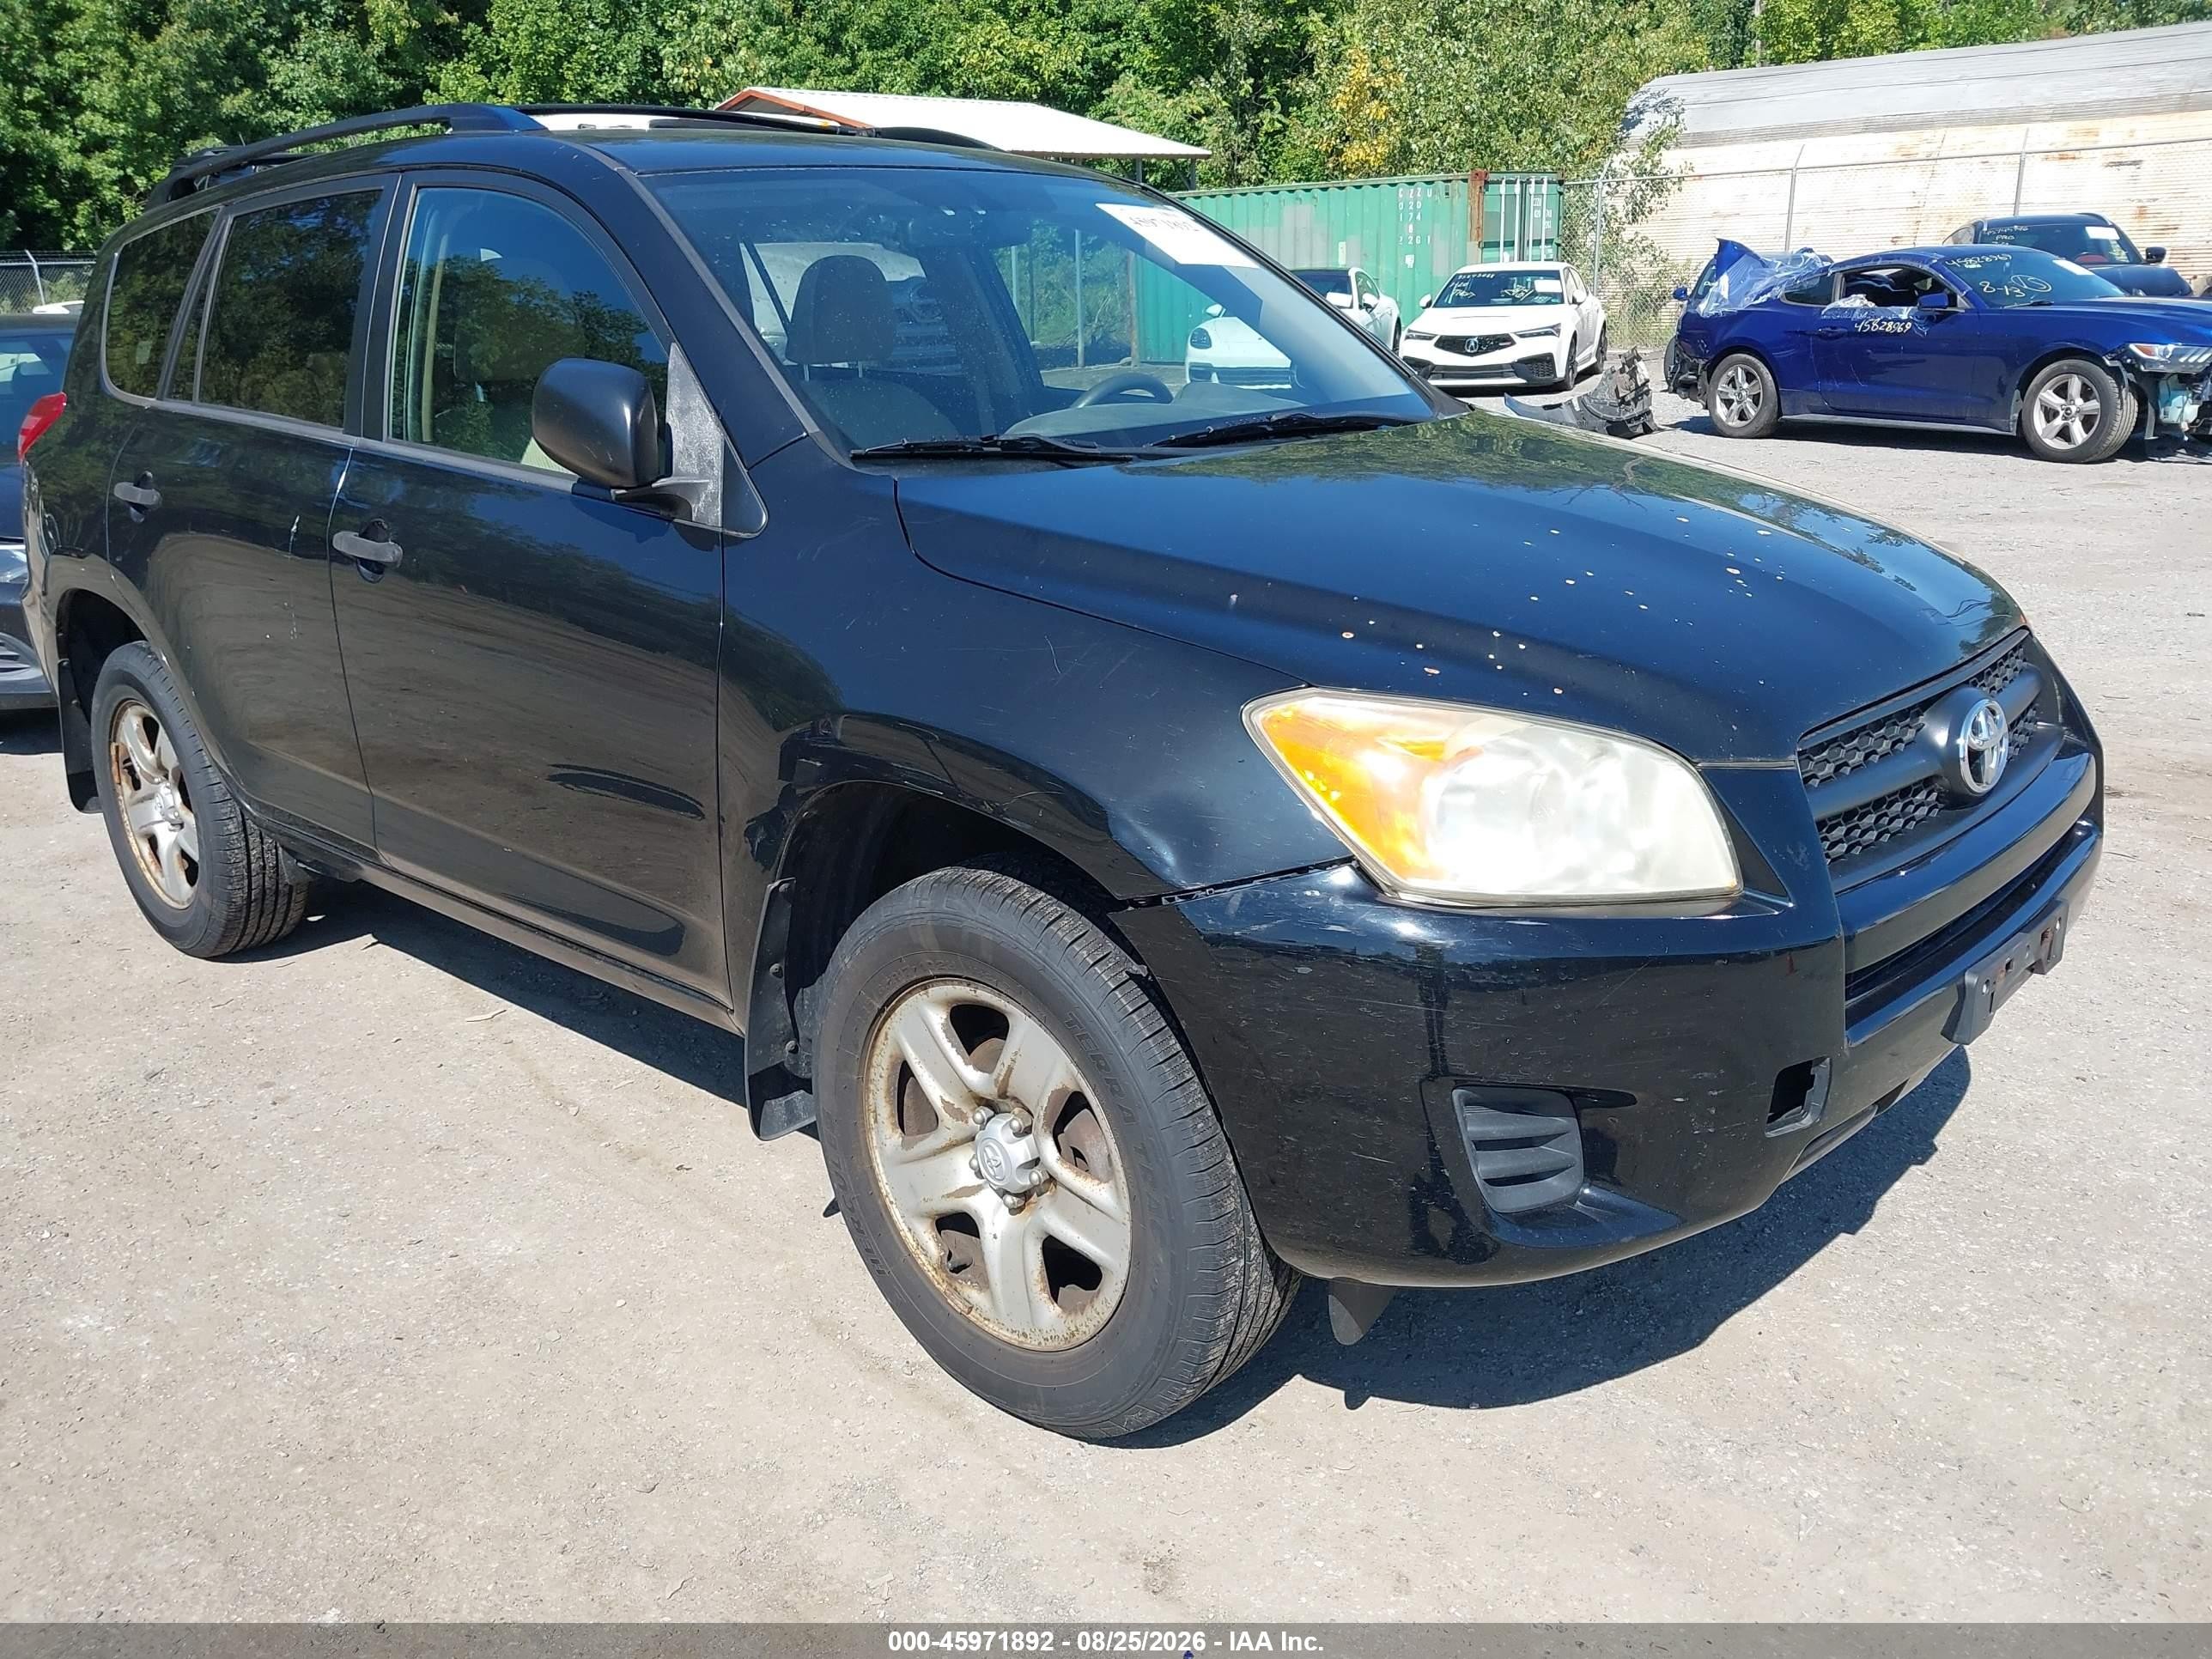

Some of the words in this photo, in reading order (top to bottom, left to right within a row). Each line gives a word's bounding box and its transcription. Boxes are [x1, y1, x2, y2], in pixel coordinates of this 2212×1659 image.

[1399, 187, 1432, 199] CZZU
[1399, 200, 1422, 210] 020
[1399, 212, 1421, 222] 174
[1855, 318, 1912, 333] 45828969
[1062, 1008, 1140, 1127] TERRA
